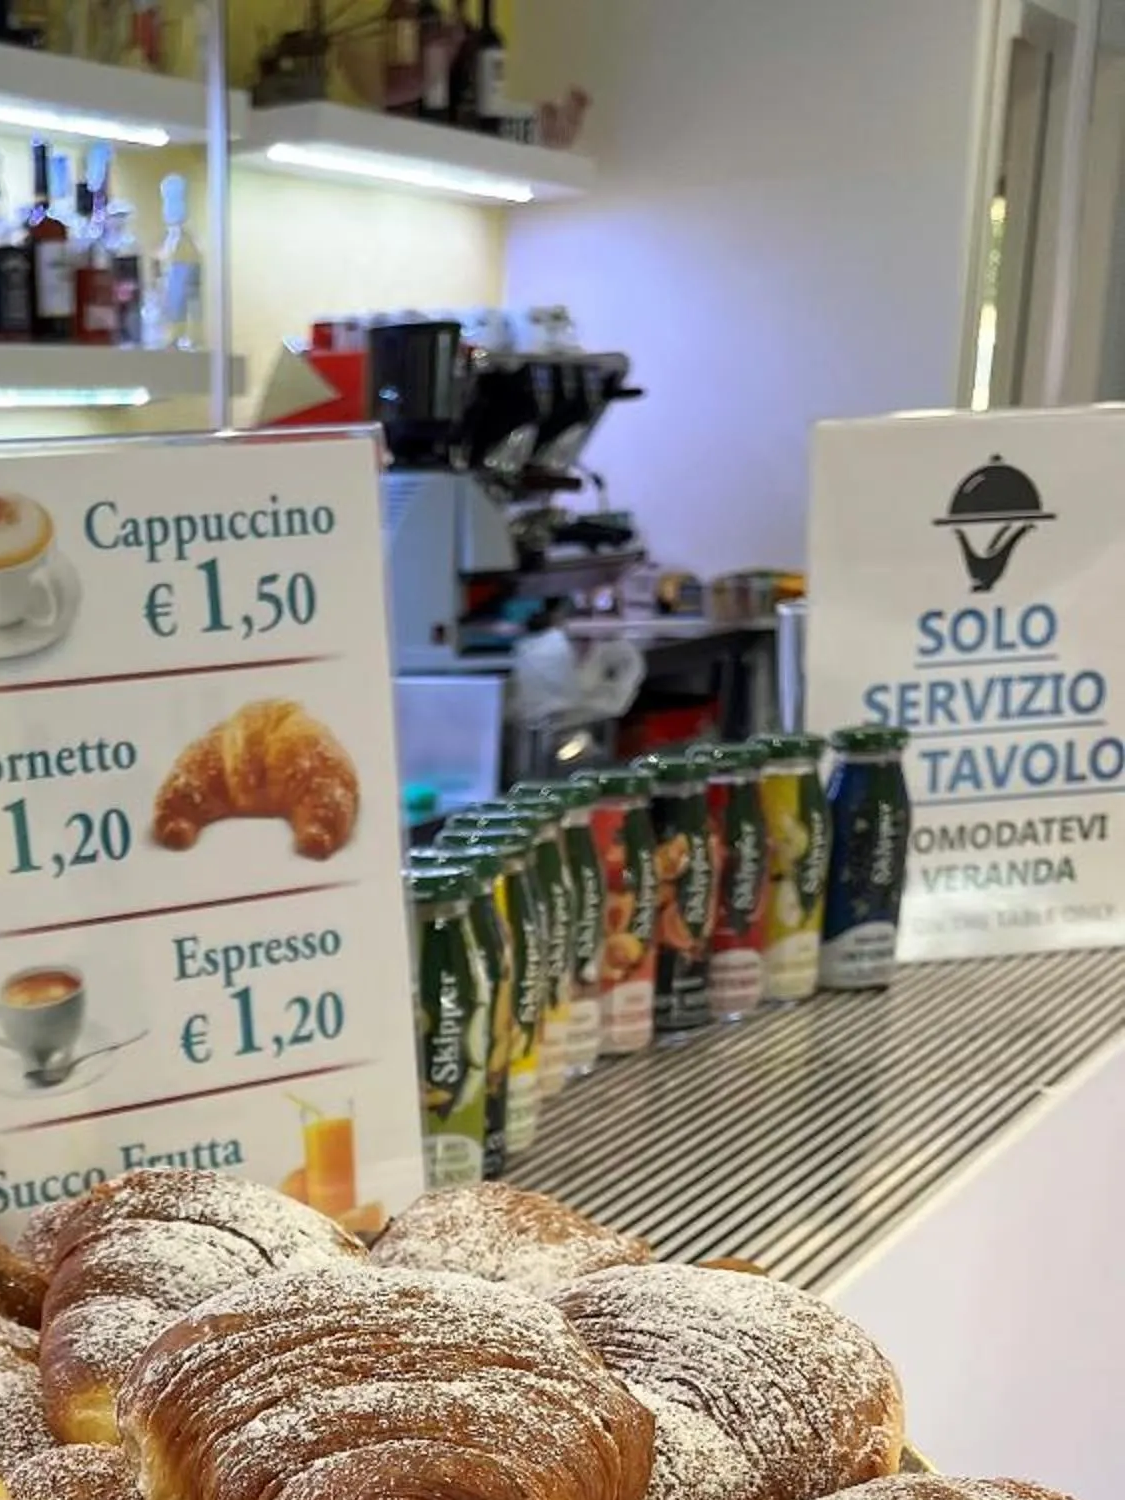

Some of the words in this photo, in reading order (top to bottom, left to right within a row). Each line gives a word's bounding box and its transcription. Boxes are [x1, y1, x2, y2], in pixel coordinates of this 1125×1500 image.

[84, 494, 335, 563] Cappuccino
[143, 583, 176, 637] €
[197, 557, 318, 640] 1,50
[917, 603, 1058, 656] SOLO
[863, 670, 1108, 728] SERVIZIO
[920, 737, 1125, 793] TAVOLO
[1, 797, 132, 879] 1,20
[912, 812, 1110, 854] OMODATEVI
[921, 855, 1078, 894] VERANDA
[173, 929, 342, 988] Espresso
[180, 1014, 212, 1064] €
[229, 986, 345, 1058] 1,20
[430, 970, 465, 1084] Skipper
